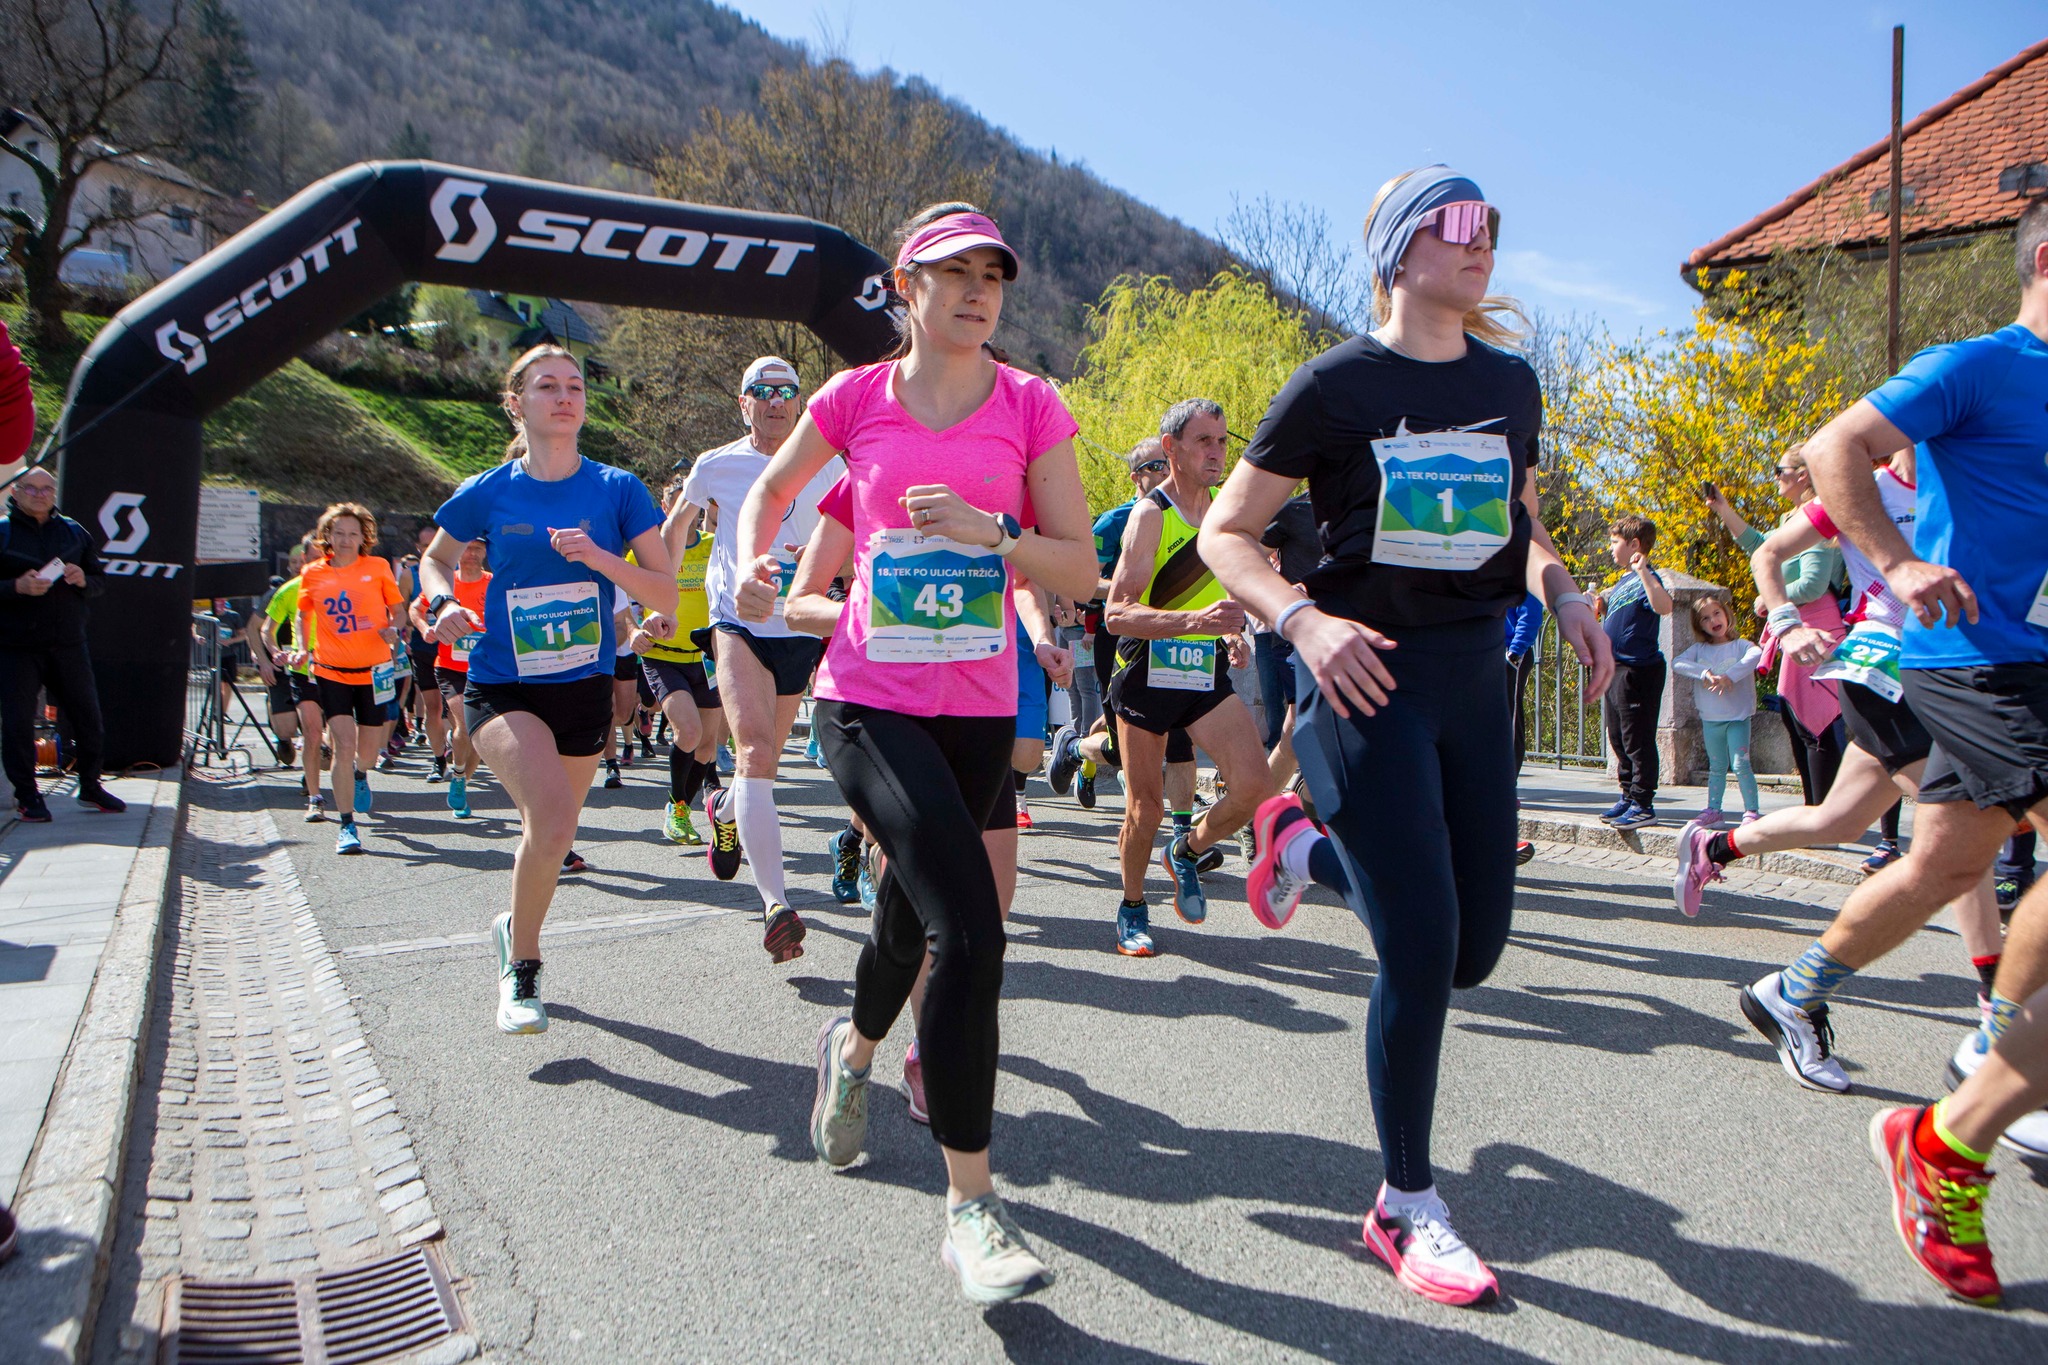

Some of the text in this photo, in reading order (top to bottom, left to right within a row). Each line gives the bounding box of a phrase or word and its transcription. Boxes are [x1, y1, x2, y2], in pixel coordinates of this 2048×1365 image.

[505, 208, 815, 277] SCOTT
[204, 217, 363, 343] SCOTT
[1407, 472, 1424, 480] TEK
[1425, 472, 1438, 481] PO
[1440, 473, 1472, 482] ULICAH
[1437, 488, 1453, 523] 1
[98, 557, 184, 579] OTT
[877, 567, 1001, 578] 18. TEK PO ULICAH TRŽIČA
[913, 583, 964, 618] 43
[335, 614, 358, 633] 21
[549, 610, 573, 619] ULICAH
[573, 607, 595, 616] TRŽIČA
[541, 620, 571, 645] 11
[1167, 646, 1204, 667] 108
[1851, 644, 1889, 663] 27
